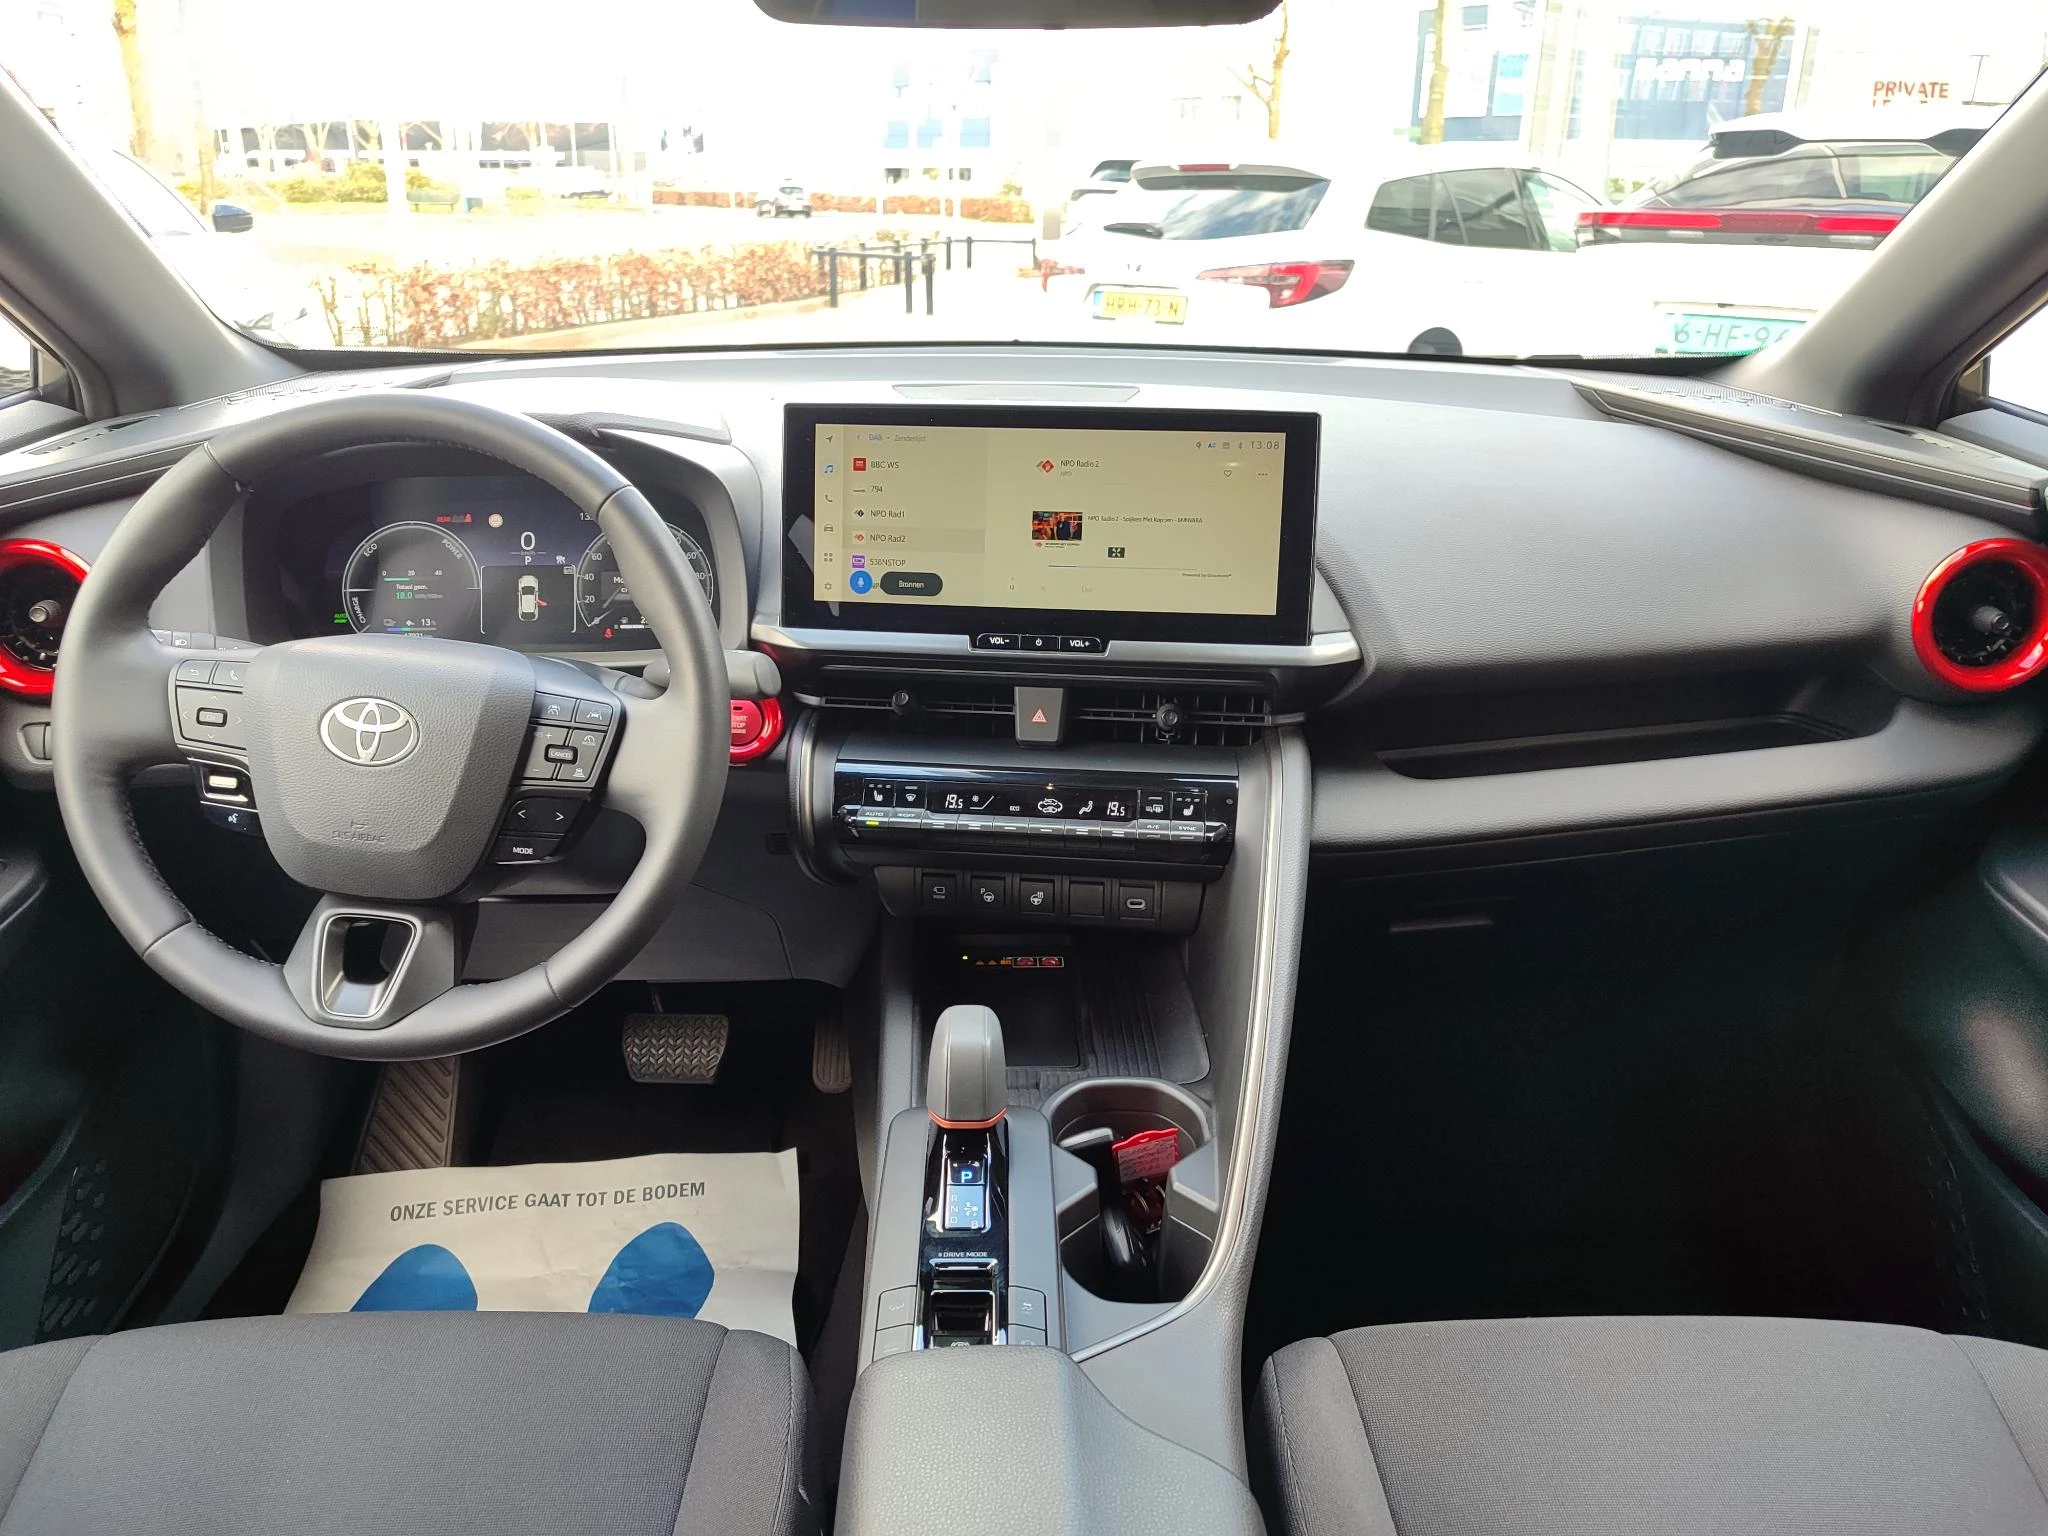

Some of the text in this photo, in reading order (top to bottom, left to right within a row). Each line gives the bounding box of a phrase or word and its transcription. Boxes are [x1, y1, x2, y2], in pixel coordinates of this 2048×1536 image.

[1873, 80, 1949, 98] PRIVATE
[1250, 441, 1280, 450] 13:08
[870, 461, 899, 469] BBC WS
[1060, 459, 1075, 468] NPO
[870, 510, 887, 518] NPO
[520, 531, 536, 551] 0
[869, 534, 906, 543] NPO Rad2
[363, 543, 378, 558] ECO
[441, 538, 463, 560] POWER
[525, 556, 532, 565] P
[584, 573, 595, 581] 40
[898, 580, 925, 590] Bronnen
[396, 592, 413, 600] 18.0
[584, 595, 595, 603] 20
[352, 596, 367, 625] CHARGE
[512, 846, 533, 855] MODE
[961, 1171, 972, 1184] P
[389, 1181, 706, 1222] ONZE SERVICE GAAT TOT DE BODEM
[951, 1194, 958, 1202] R
[950, 1205, 959, 1213] N
[951, 1216, 958, 1224] D
[971, 1220, 978, 1229] B
